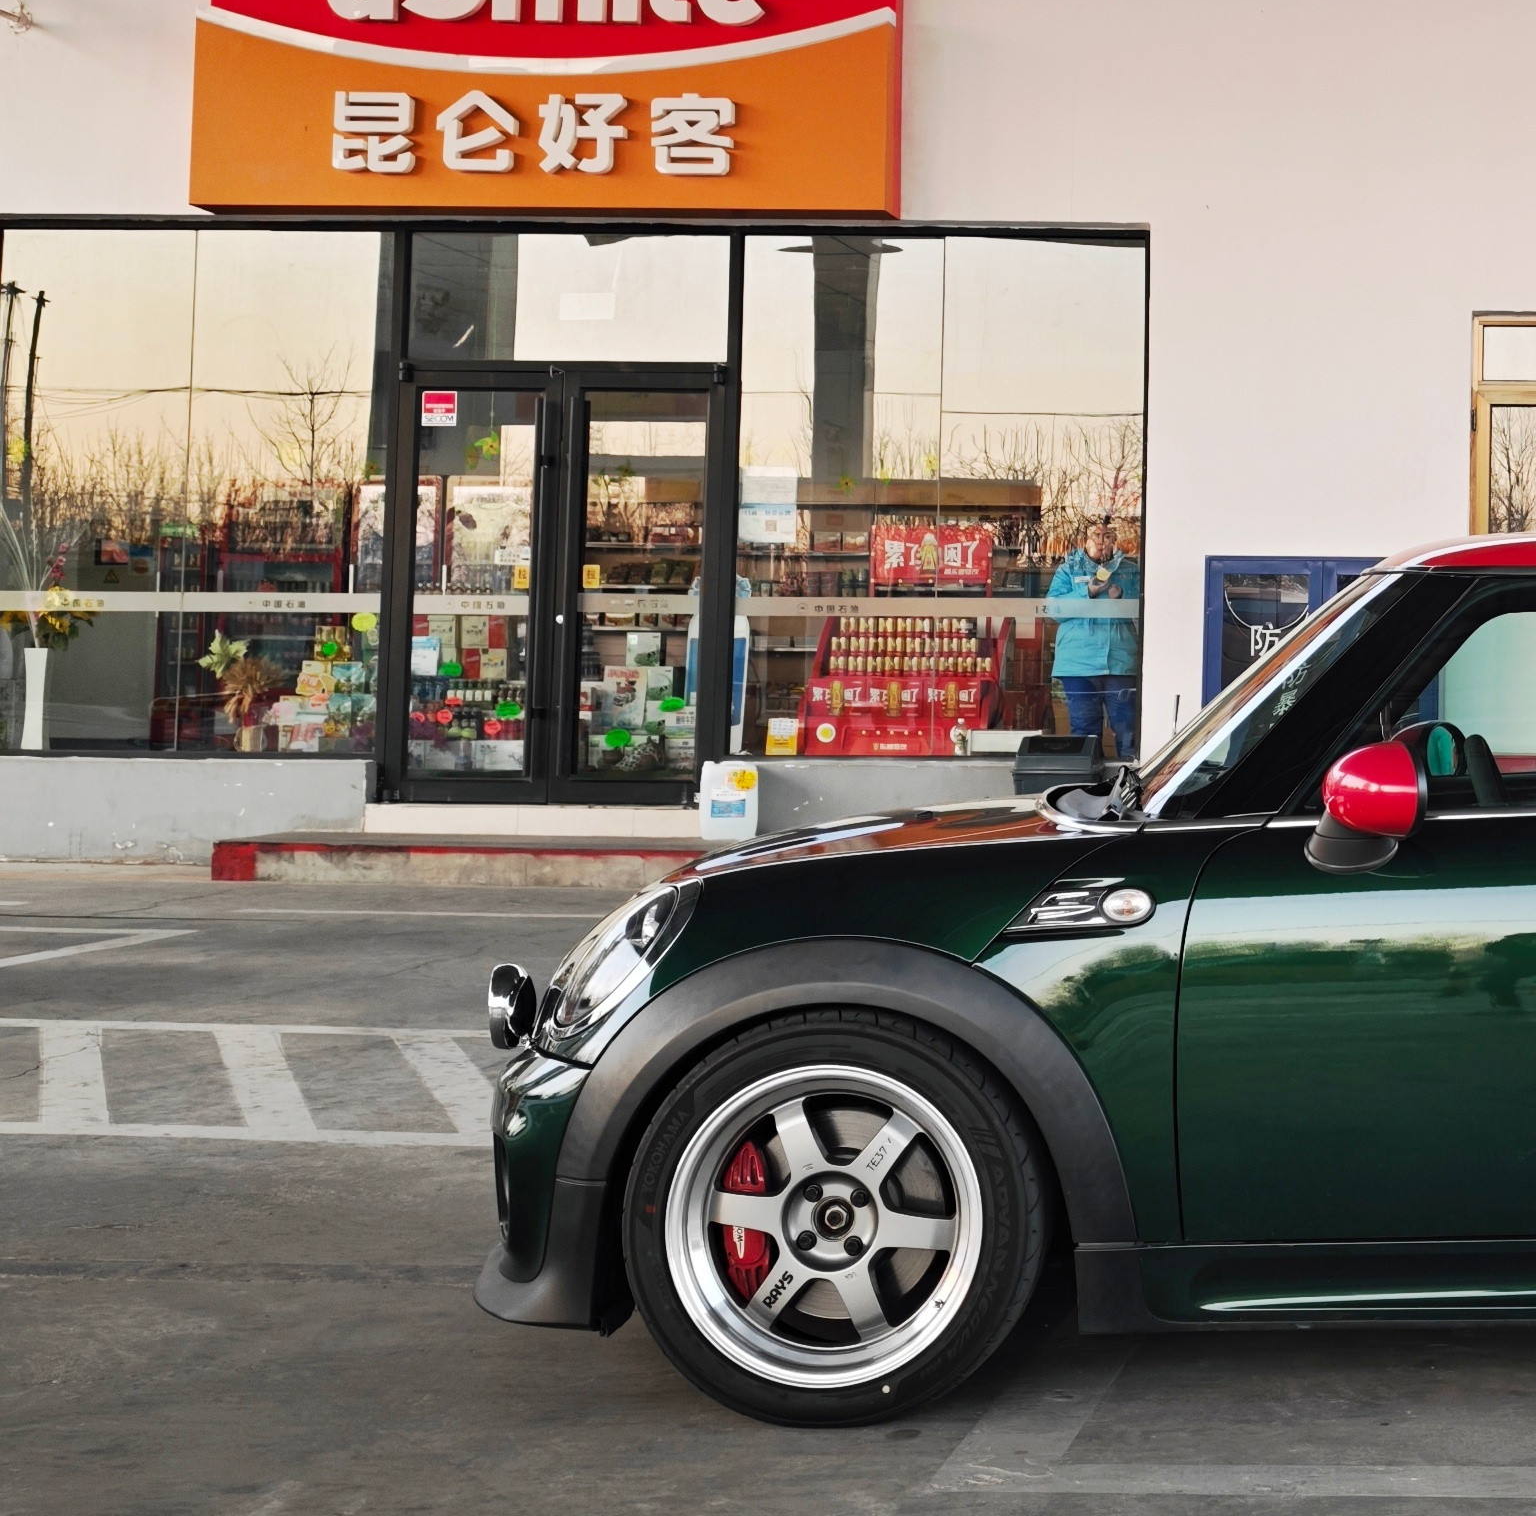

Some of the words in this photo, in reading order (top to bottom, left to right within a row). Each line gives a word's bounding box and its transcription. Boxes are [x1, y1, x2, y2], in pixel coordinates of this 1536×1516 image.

[332, 90, 736, 176] 昆仑好客
[762, 1270, 794, 1310] RAYS
